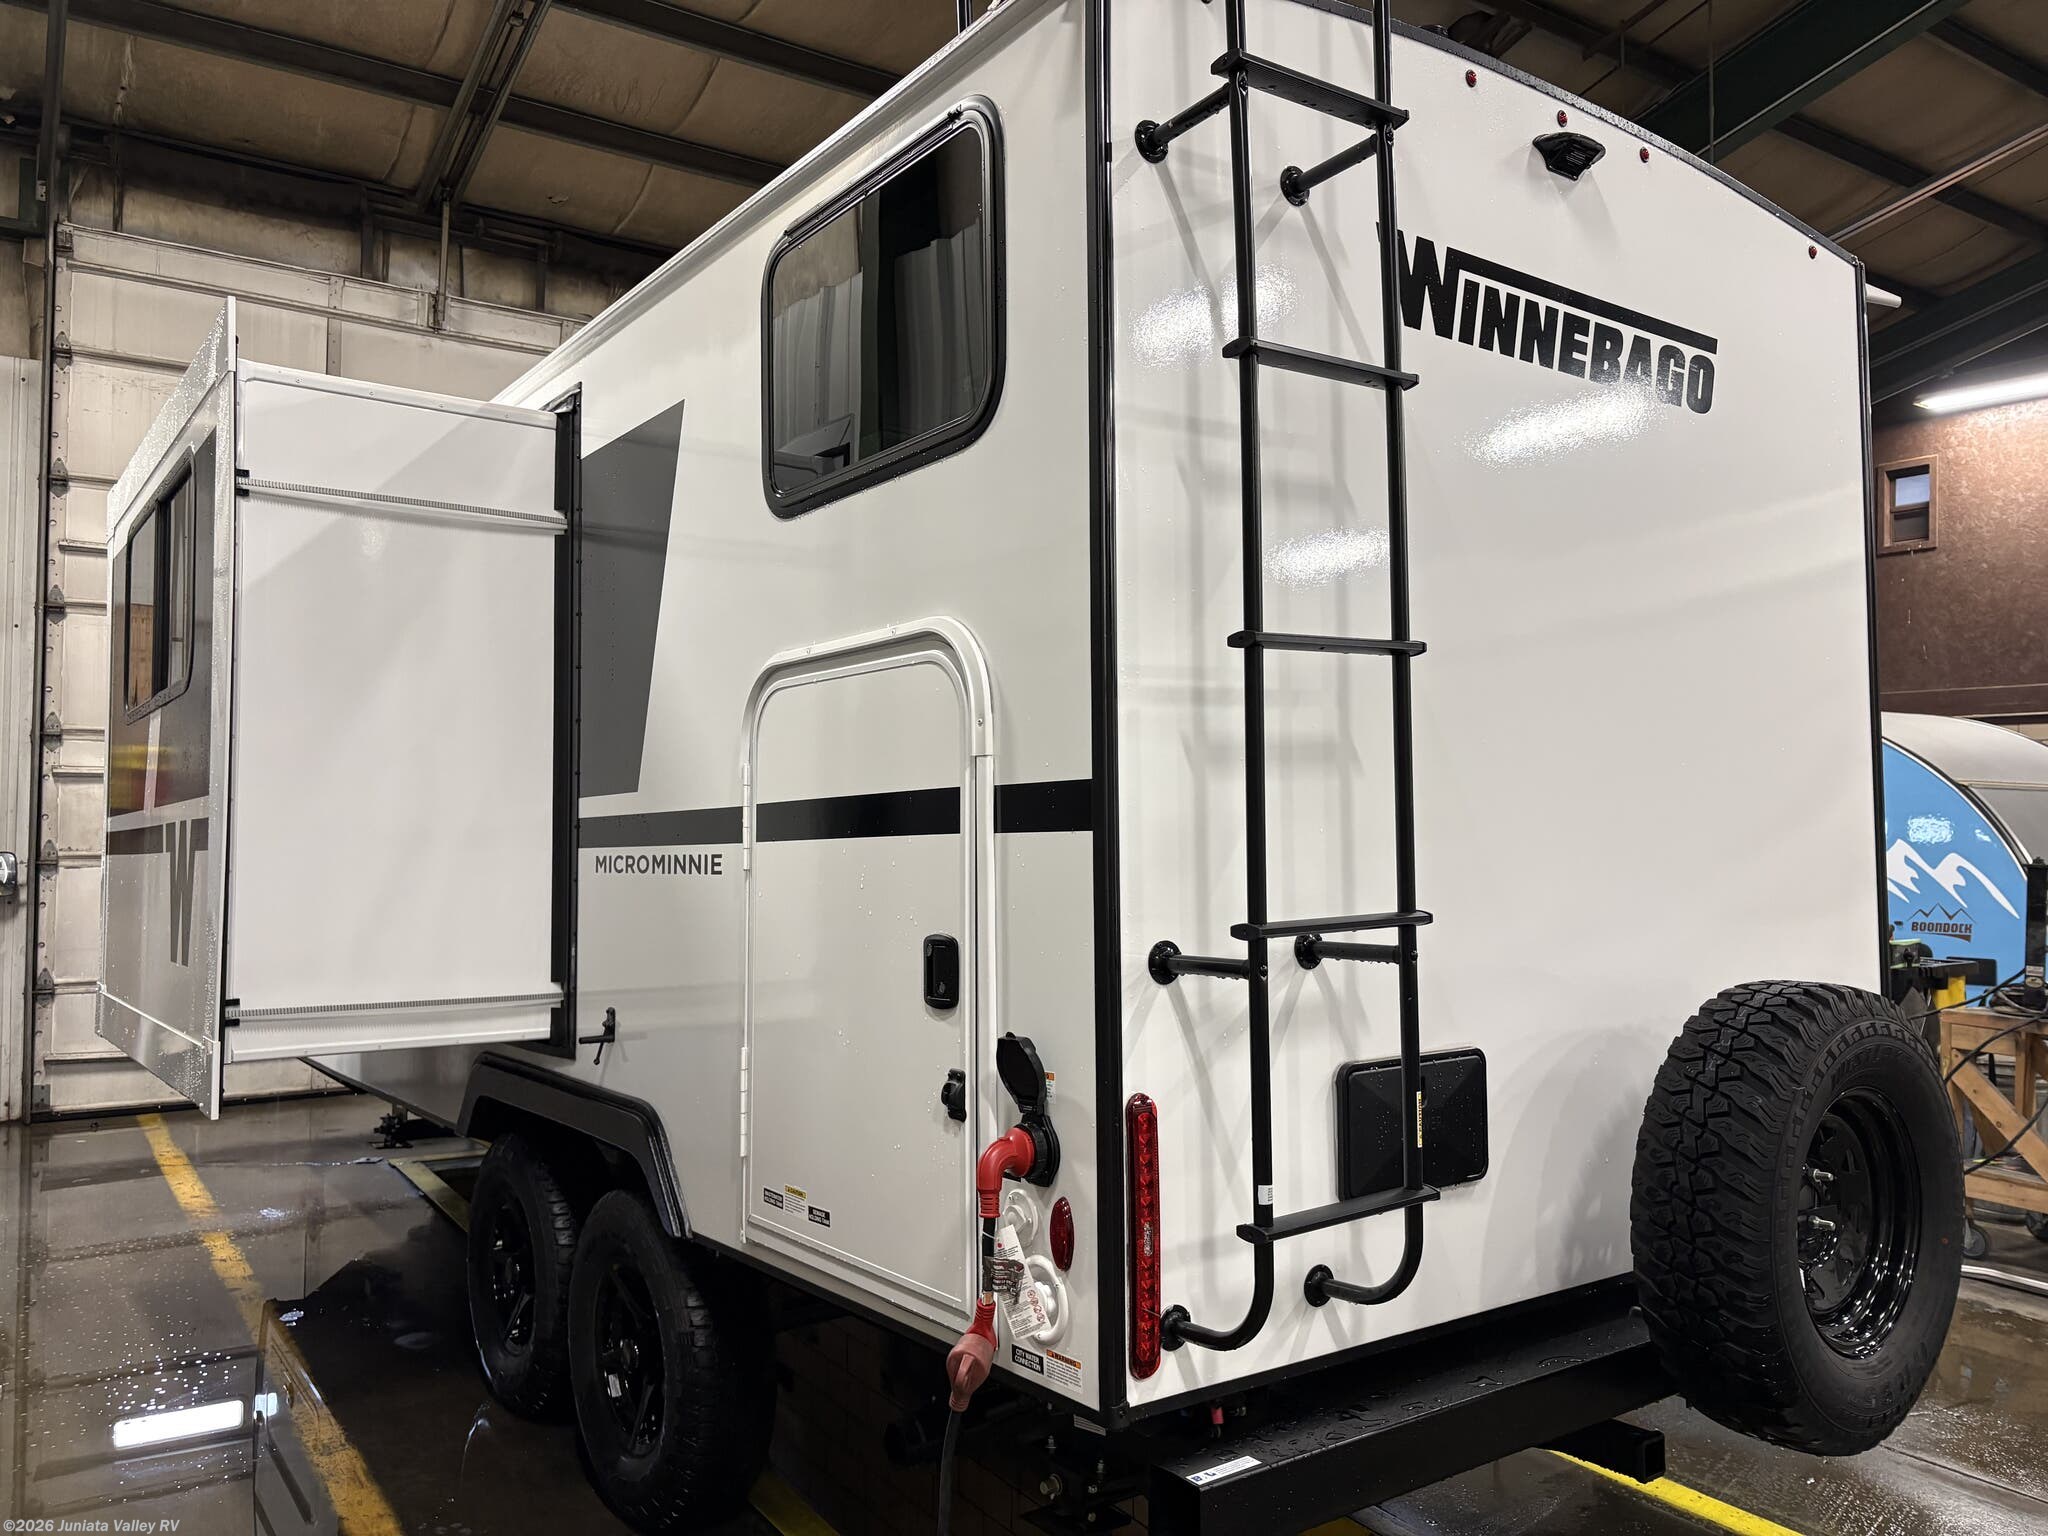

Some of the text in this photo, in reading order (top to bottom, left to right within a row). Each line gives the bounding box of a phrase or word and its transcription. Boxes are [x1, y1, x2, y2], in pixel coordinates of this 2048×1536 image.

[1376, 222, 1717, 414] WINNEBAGO
[595, 854, 723, 875] MICROMINNIE
[1911, 921, 1973, 934] BOONDOCK
[1014, 1355, 1041, 1371] CONNECTION
